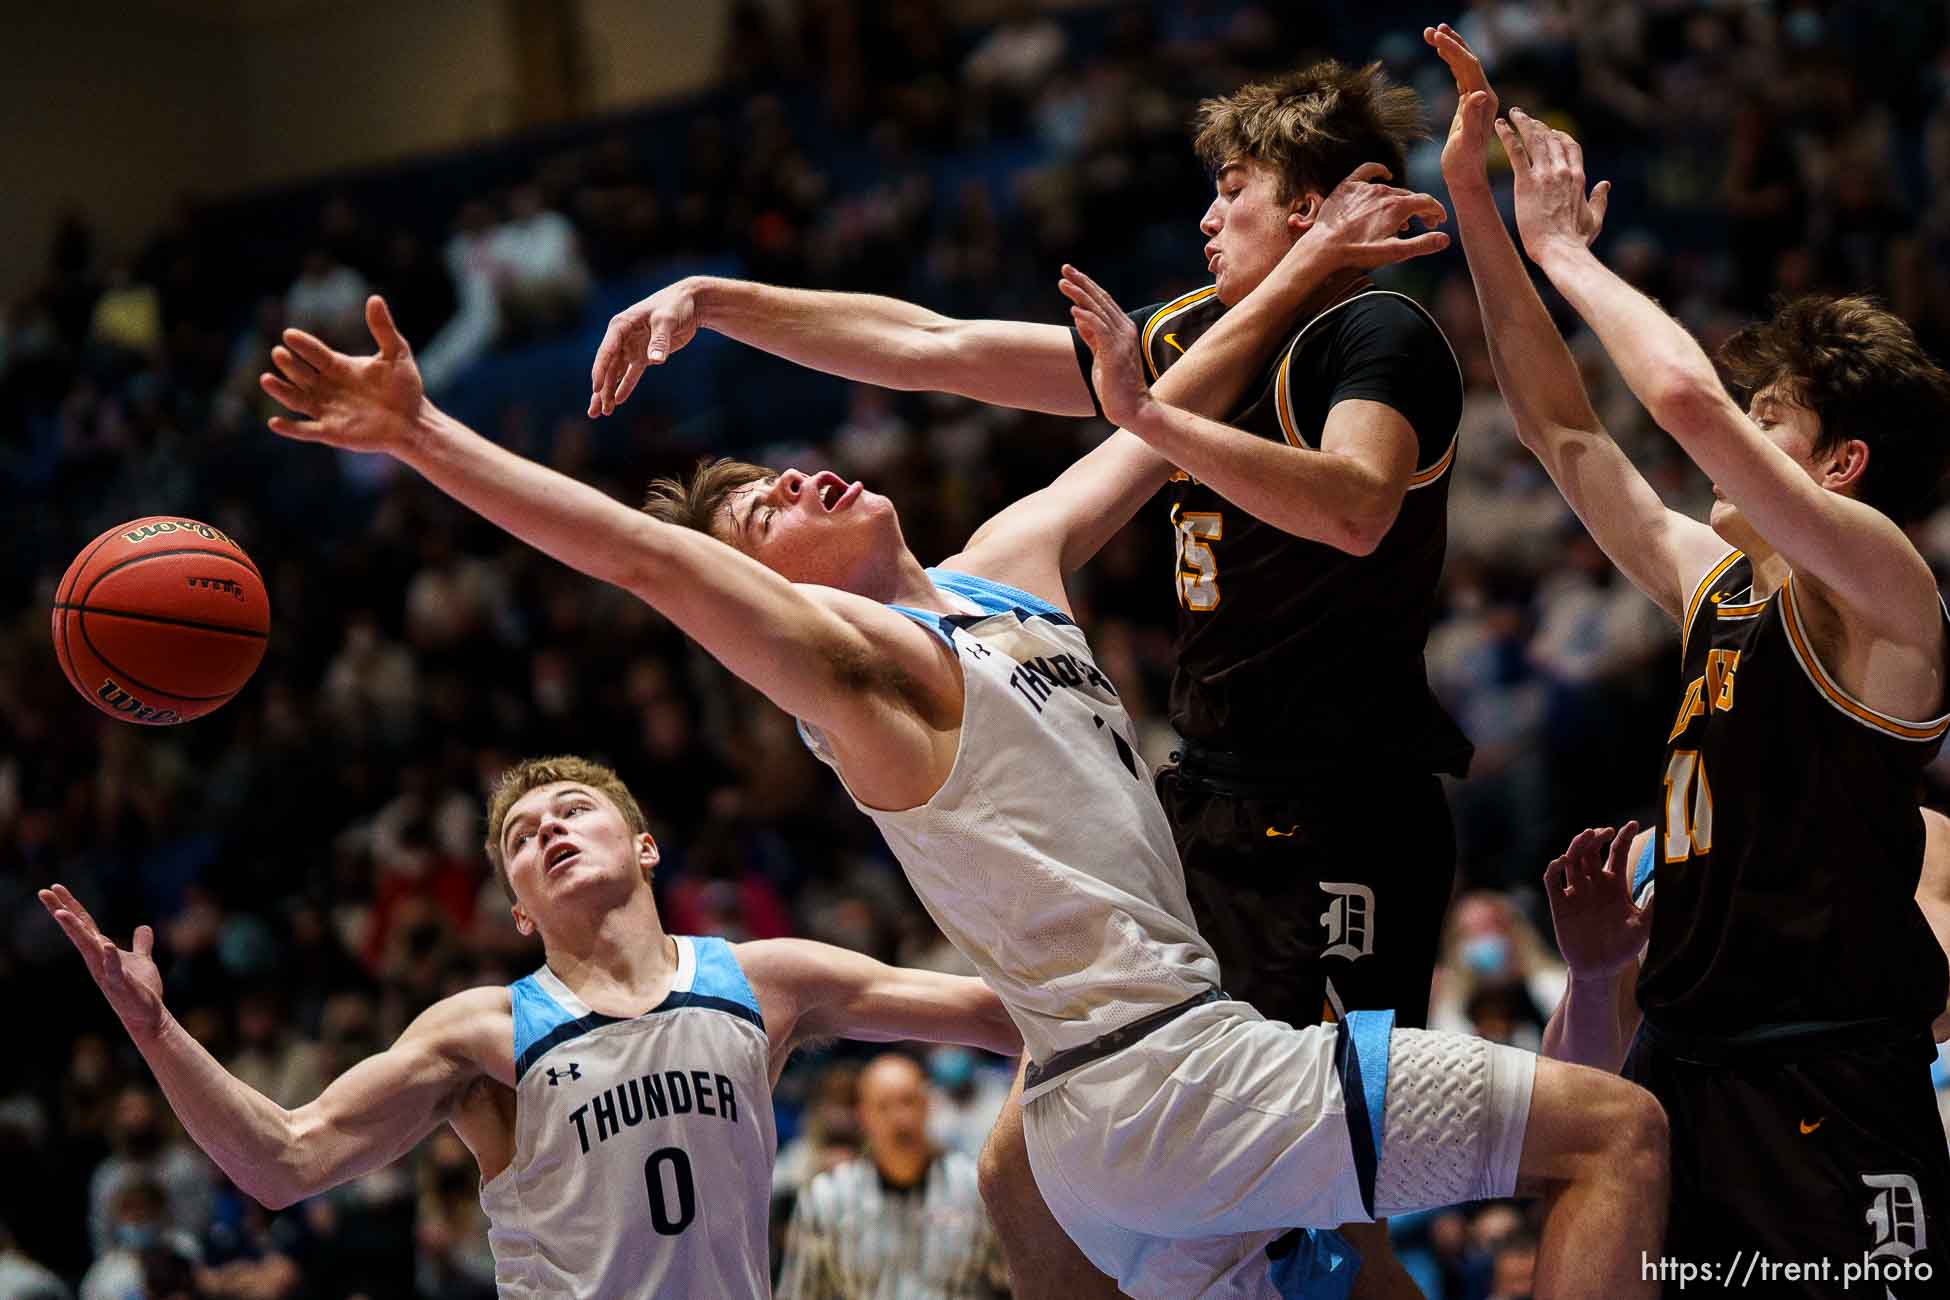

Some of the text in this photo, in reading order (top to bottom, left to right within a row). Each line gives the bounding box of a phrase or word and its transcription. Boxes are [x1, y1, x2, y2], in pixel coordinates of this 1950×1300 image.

[1319, 878, 1375, 962] D
[569, 1070, 738, 1155] THUNDER
[644, 1147, 696, 1236] 0
